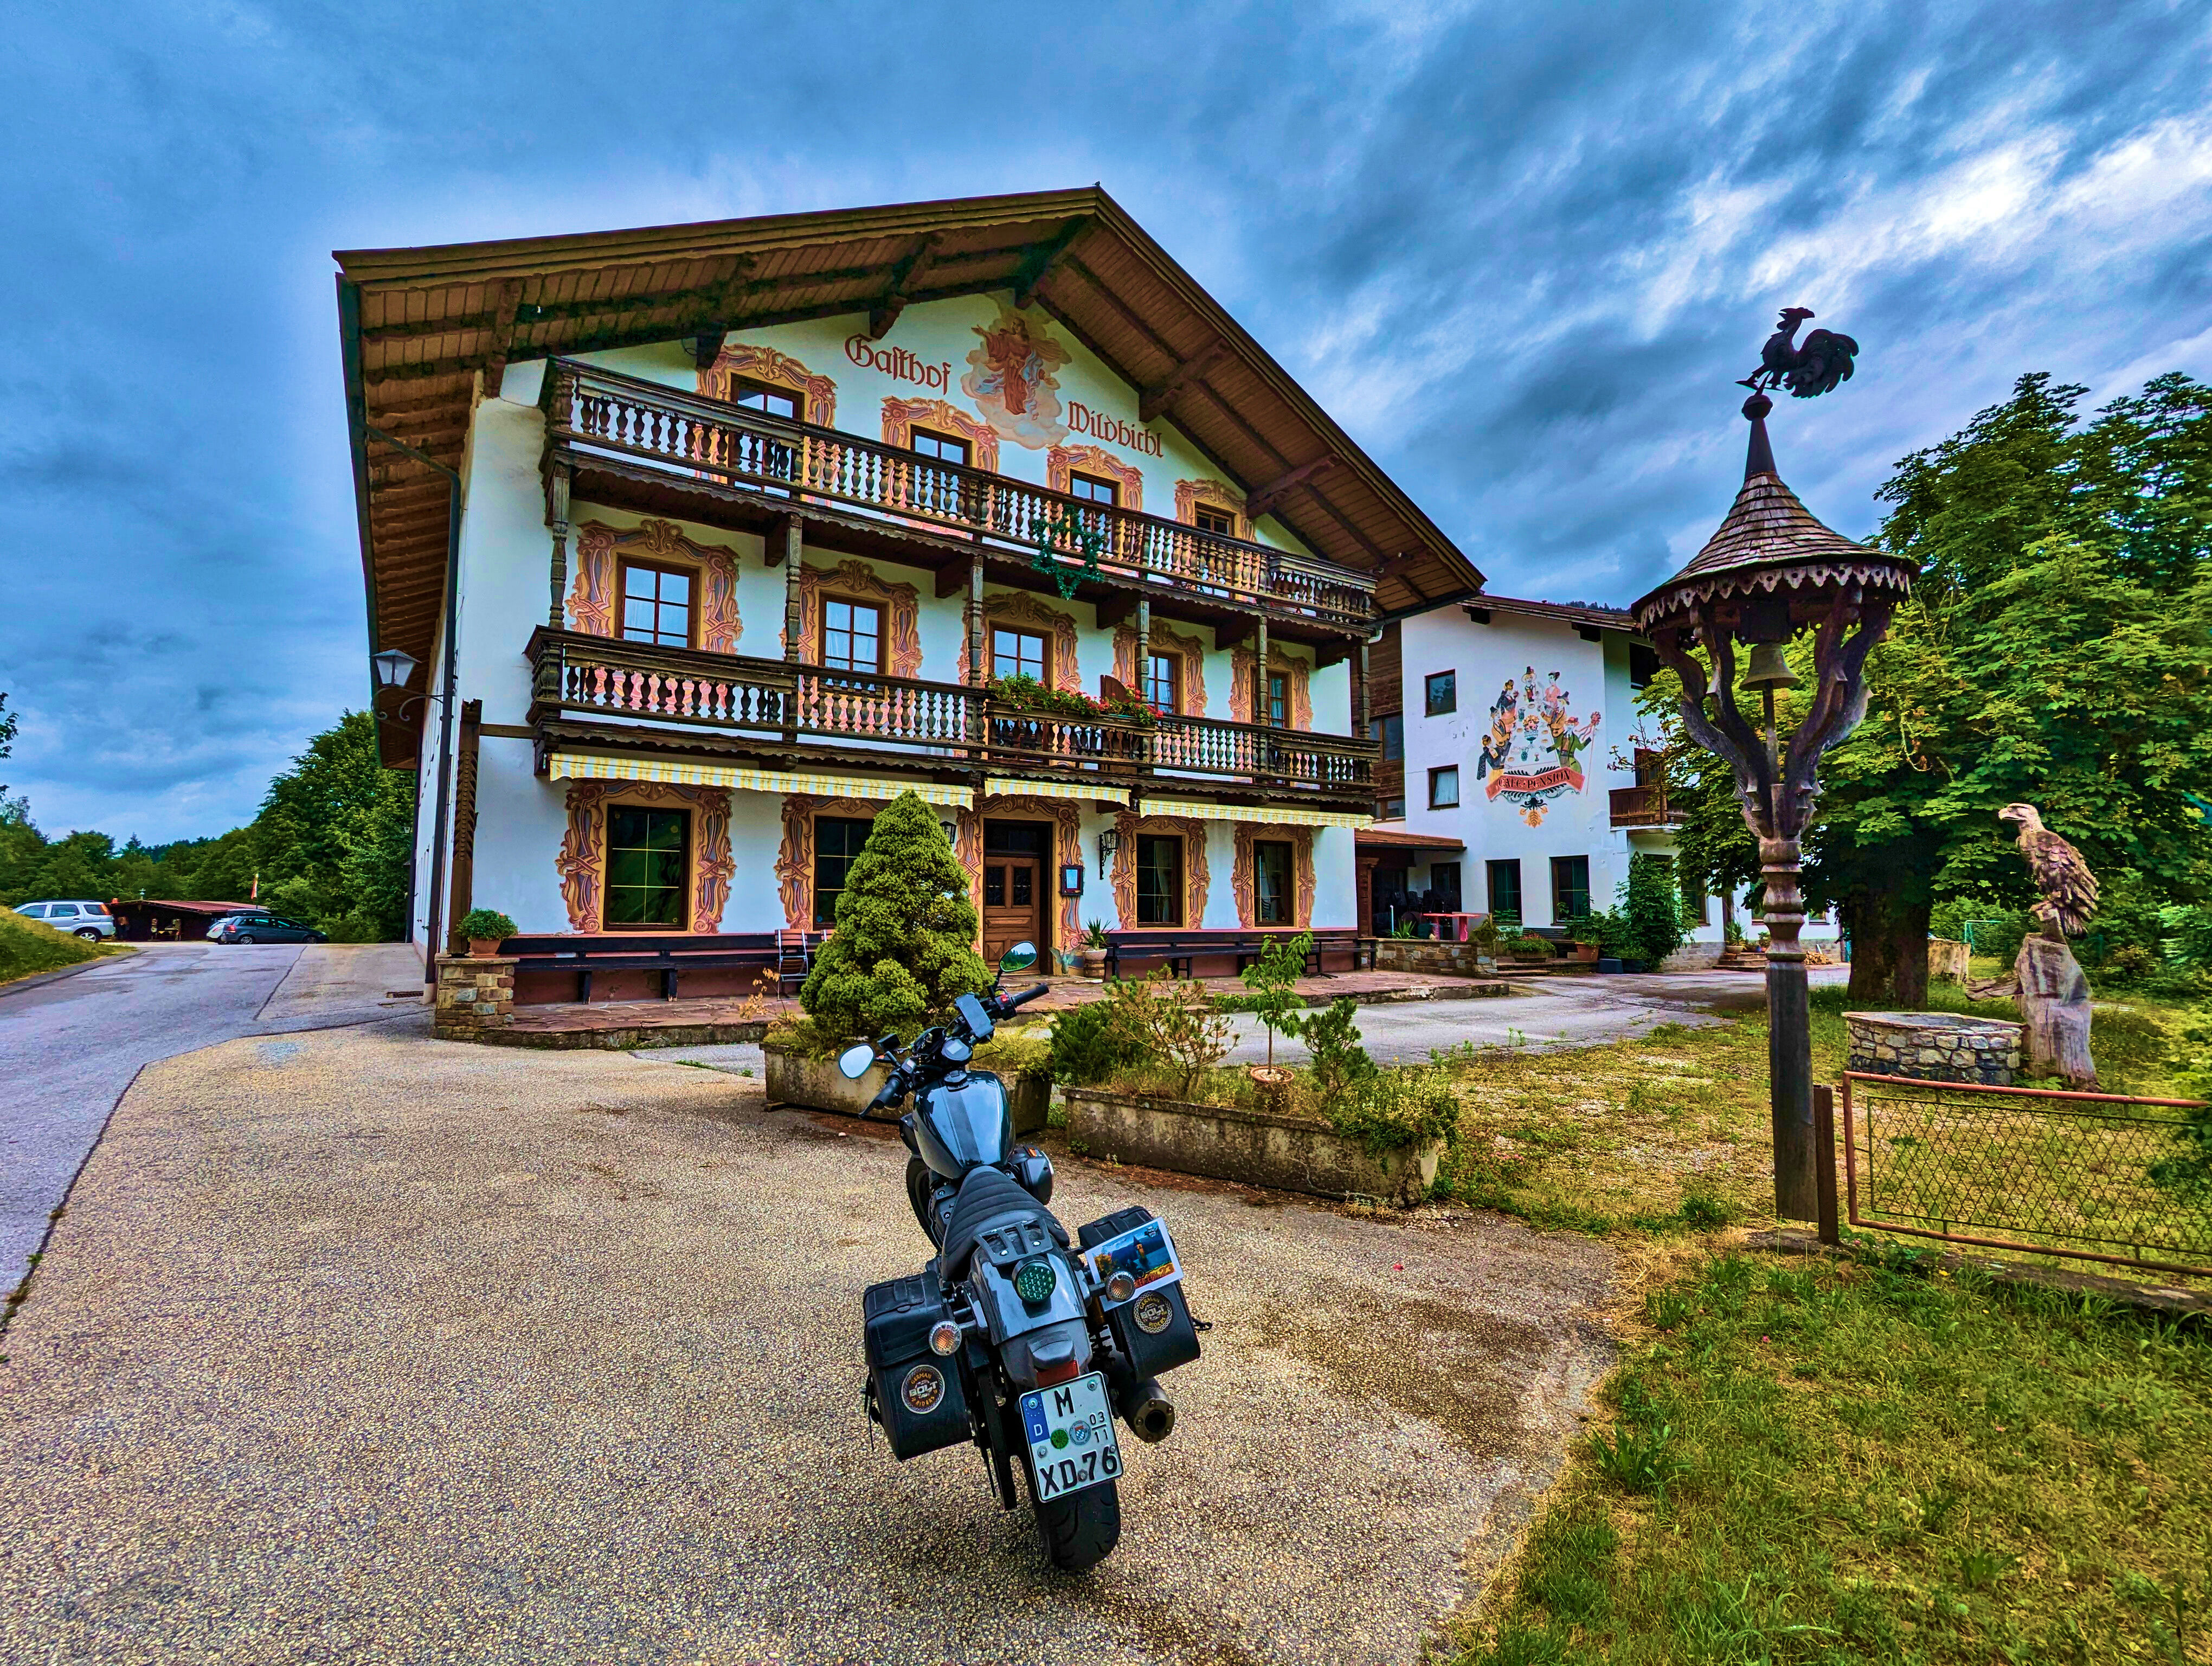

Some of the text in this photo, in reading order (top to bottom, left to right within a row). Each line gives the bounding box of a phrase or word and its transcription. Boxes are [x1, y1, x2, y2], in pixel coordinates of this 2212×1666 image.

[1068, 400, 1164, 458] Wildbichl
[1527, 770, 1571, 789] PENSION
[1140, 1304, 1165, 1319] BOLT
[1148, 1317, 1166, 1328] RIDERS
[911, 1372, 932, 1384] GERMAN
[909, 1381, 938, 1398] BOLT
[916, 1396, 935, 1406] RIDERS
[1054, 1386, 1075, 1418] M
[1089, 1411, 1106, 1425] 03
[1033, 1424, 1044, 1437] D
[1095, 1428, 1108, 1443] 11
